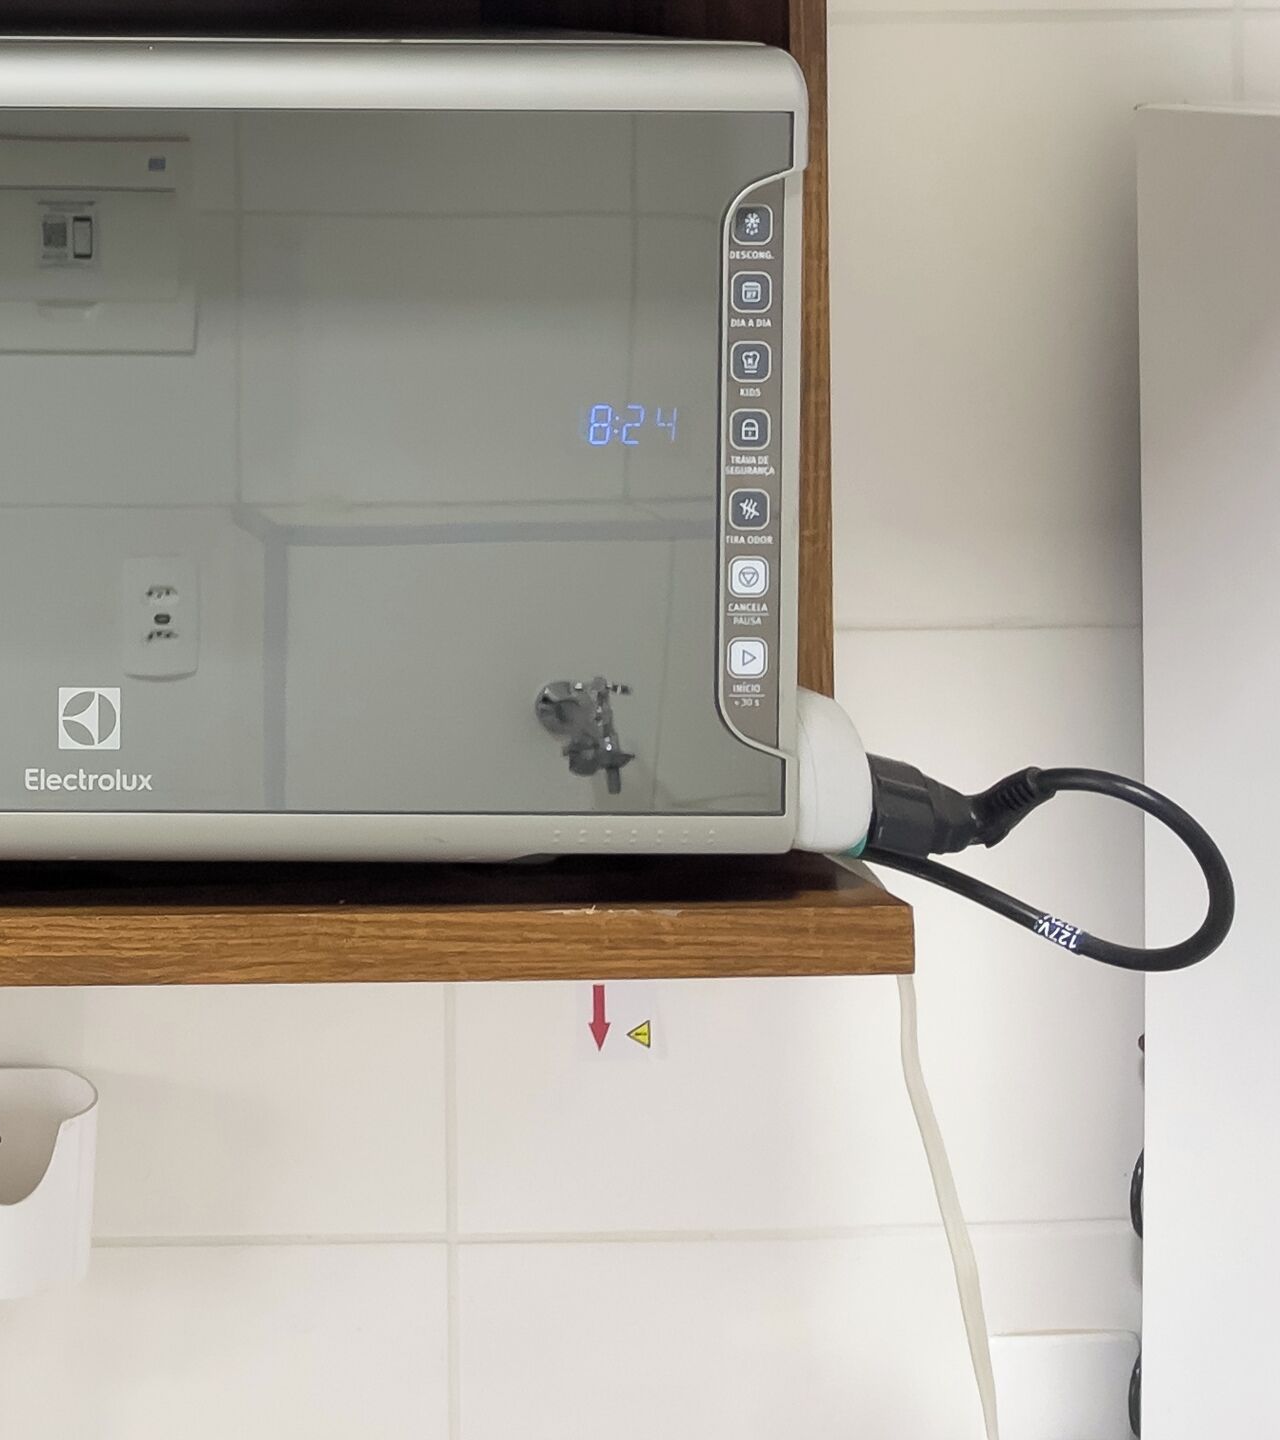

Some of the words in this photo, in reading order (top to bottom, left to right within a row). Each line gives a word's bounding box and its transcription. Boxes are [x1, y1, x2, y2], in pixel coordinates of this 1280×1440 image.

[729, 250, 775, 260] DESCONG.
[730, 318, 746, 328] DIA
[748, 318, 755, 328] A
[756, 318, 772, 328] DIA
[740, 387, 761, 397] KIDS
[590, 405, 678, 445] 8:24
[726, 535, 746, 545] TIRA
[747, 535, 774, 545] ODOR
[727, 602, 768, 612] CANCELA
[733, 616, 762, 626] PAUSA
[24, 768, 153, 791] Electrolux
